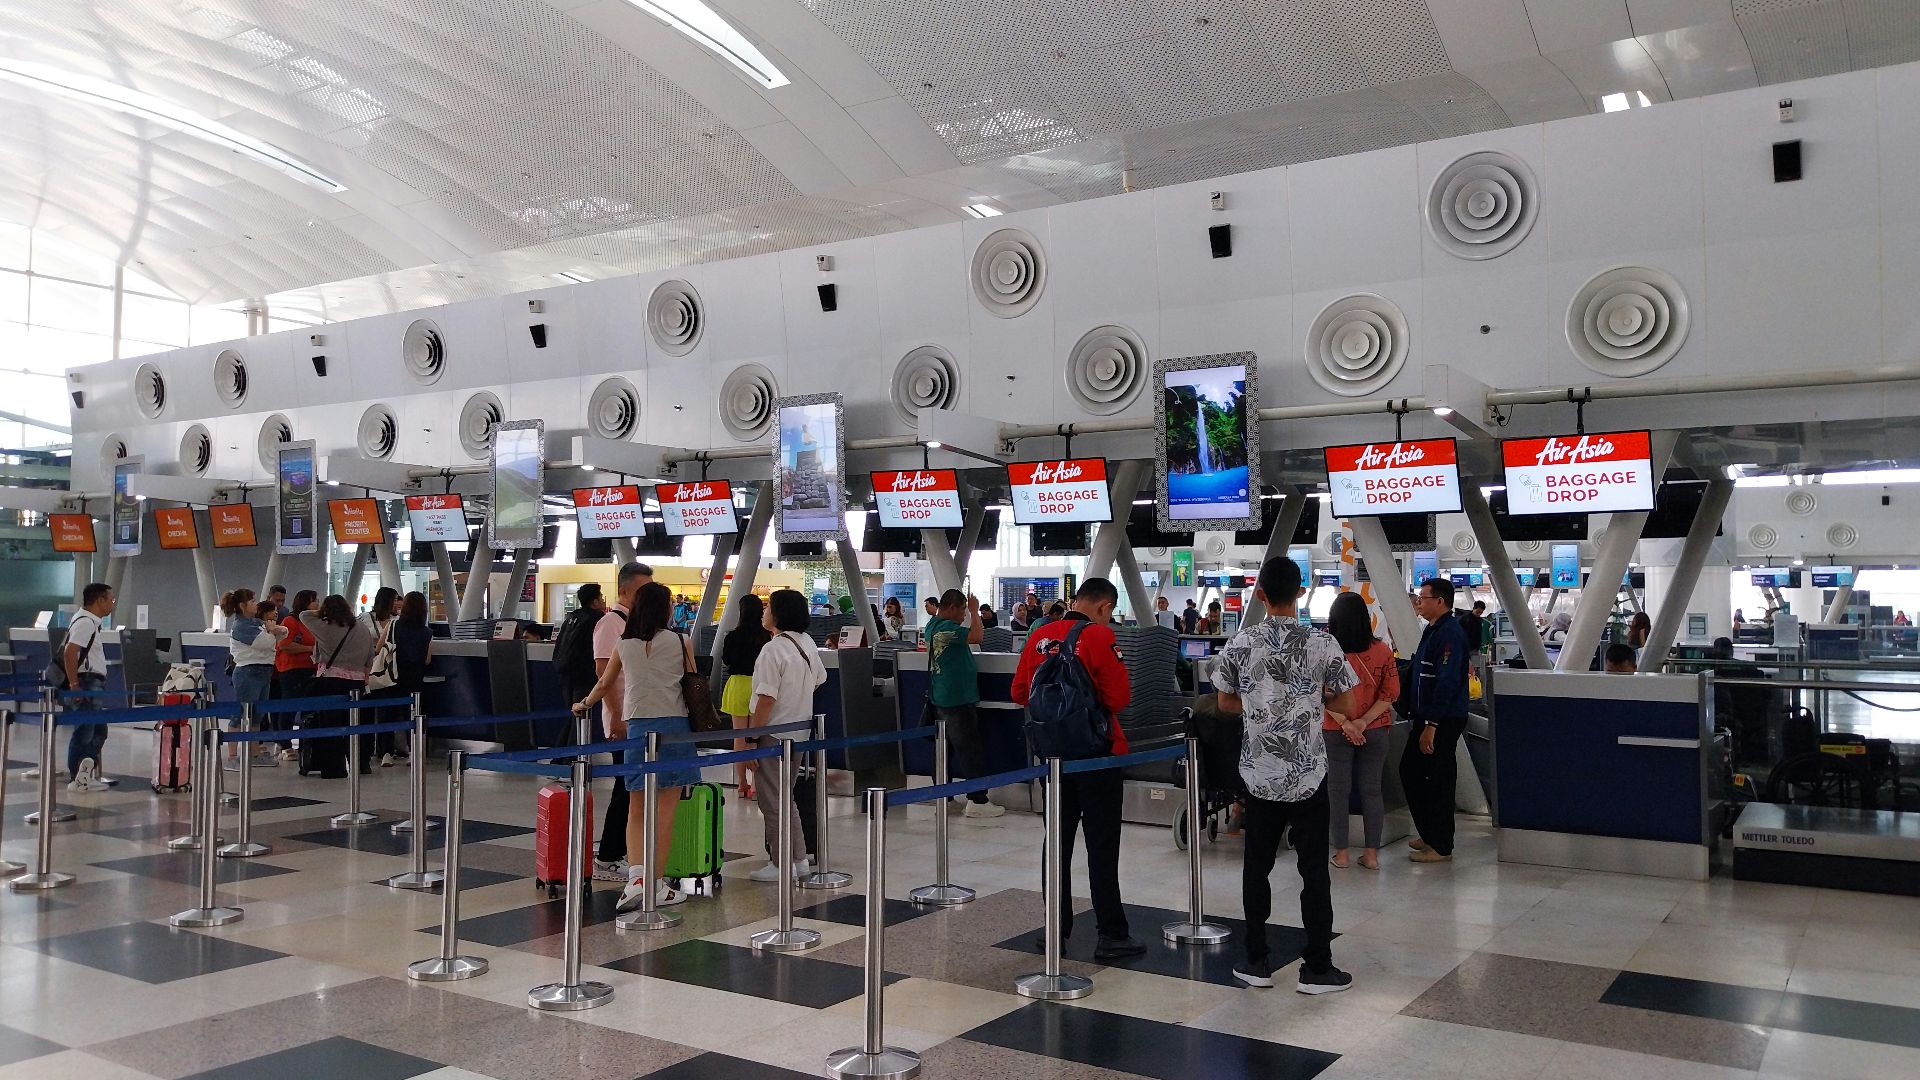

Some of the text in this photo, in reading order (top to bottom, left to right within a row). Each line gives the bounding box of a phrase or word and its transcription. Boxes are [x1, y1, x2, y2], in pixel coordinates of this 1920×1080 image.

[1364, 475, 1446, 491] BAGGAGE
[1545, 471, 1637, 487] BAGGAGE
[1038, 489, 1099, 501] BAGGAGE
[1366, 491, 1412, 504] DROP
[1547, 489, 1599, 503] DROP
[899, 498, 951, 509] BAGGAGE
[1040, 504, 1075, 514] DROP
[595, 511, 637, 521] BAGGAGE
[681, 506, 728, 518] BAGGAGE
[901, 510, 931, 520] DROP
[344, 520, 368, 528] PRIORITY
[597, 522, 621, 531] DROP
[683, 518, 710, 528] DROP
[1742, 833, 1815, 845] METTLER TOLEDO
